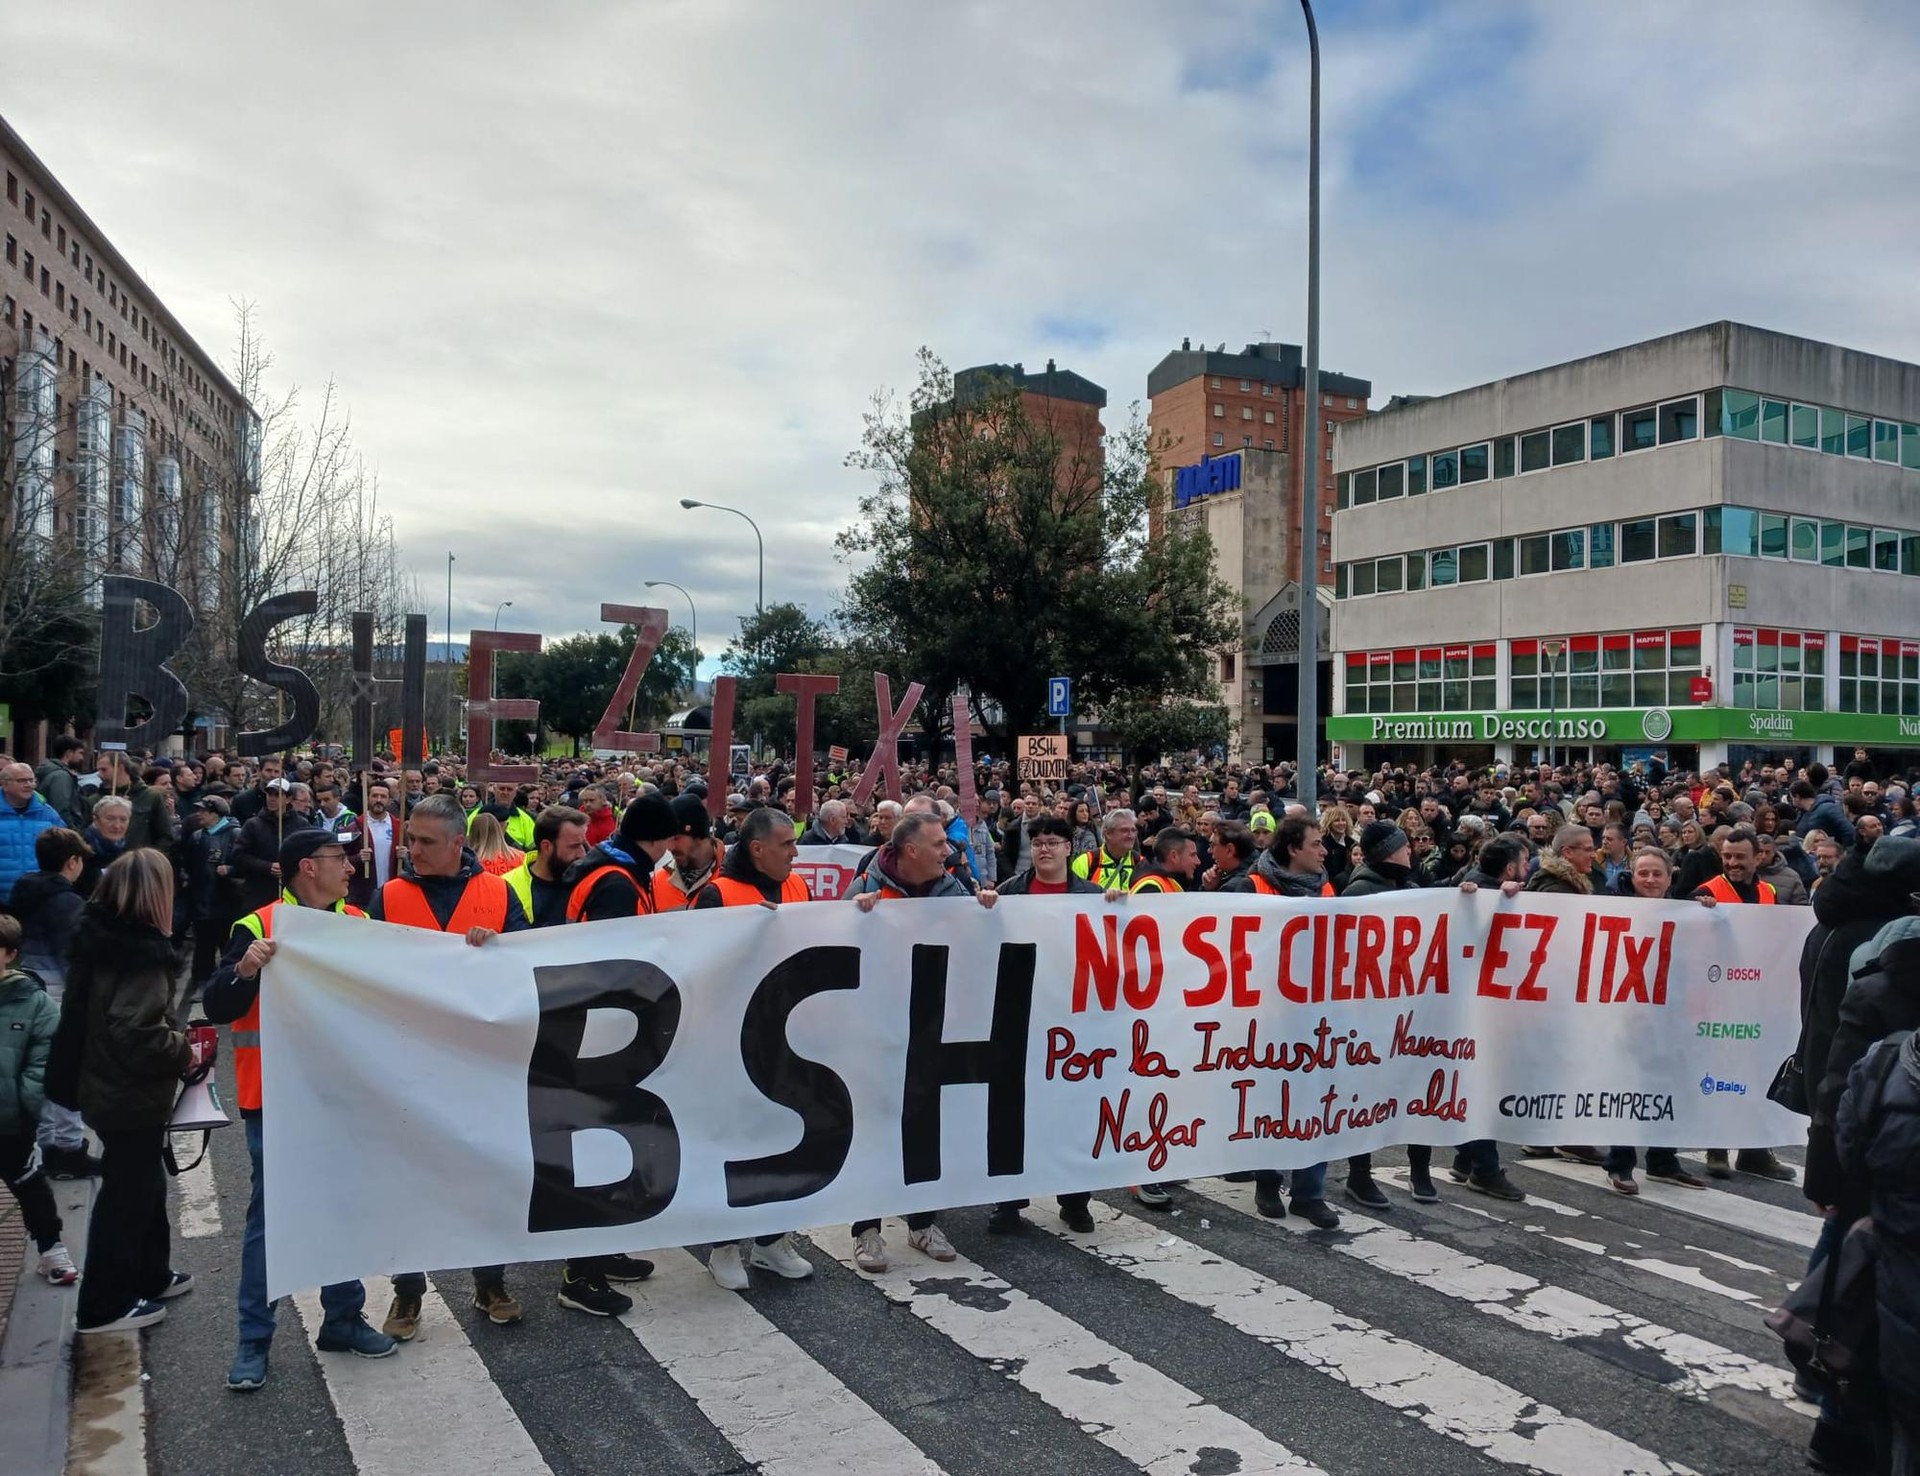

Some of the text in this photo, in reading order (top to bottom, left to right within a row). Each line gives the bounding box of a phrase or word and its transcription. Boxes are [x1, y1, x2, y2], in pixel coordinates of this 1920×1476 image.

[1636, 635, 1665, 644] MAPFRE
[1053, 682, 1065, 712] P
[1371, 716, 1474, 740] Premium
[1749, 713, 1793, 735] Spaldin
[1072, 913, 1164, 1014] NO
[1182, 915, 1263, 1008] SE
[1276, 912, 1449, 1004] CIERRA
[1476, 912, 1560, 1002] EZ
[1726, 967, 1762, 982] BOSCH
[1045, 1009, 1477, 1082] Por la Industria Navarra
[1696, 1021, 1762, 1040] SIEMENS
[527, 942, 1037, 1234] BSH
[1091, 1067, 1467, 1172] Nafar Industriaren alde
[1499, 1091, 1675, 1122] COMITE DE EMPRESA
